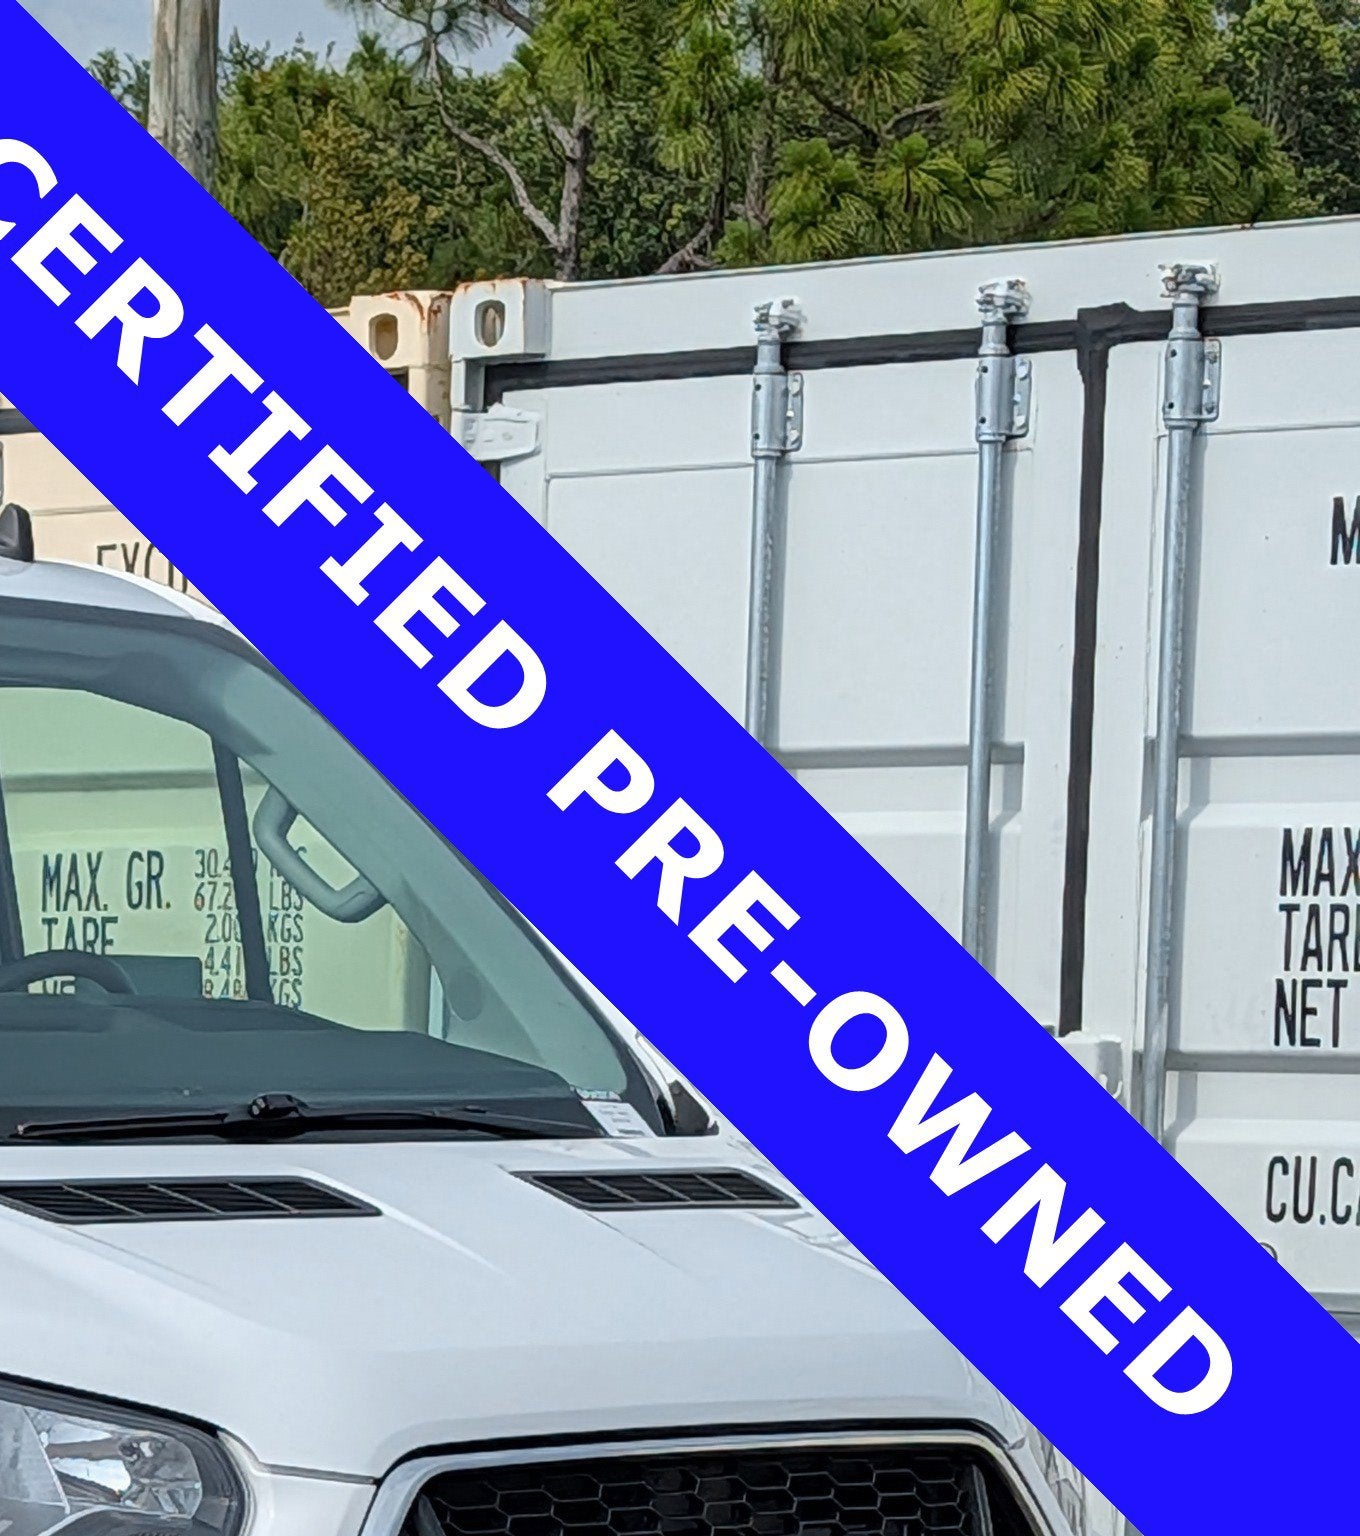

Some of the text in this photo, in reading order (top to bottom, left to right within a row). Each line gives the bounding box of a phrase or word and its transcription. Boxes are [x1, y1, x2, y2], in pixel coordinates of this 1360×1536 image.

[41, 851, 108, 912] MAX.
[126, 850, 171, 911] GR.
[266, 912, 304, 943] KGS
[1274, 978, 1349, 1048] NET
[1266, 1155, 1360, 1226] CU.C
